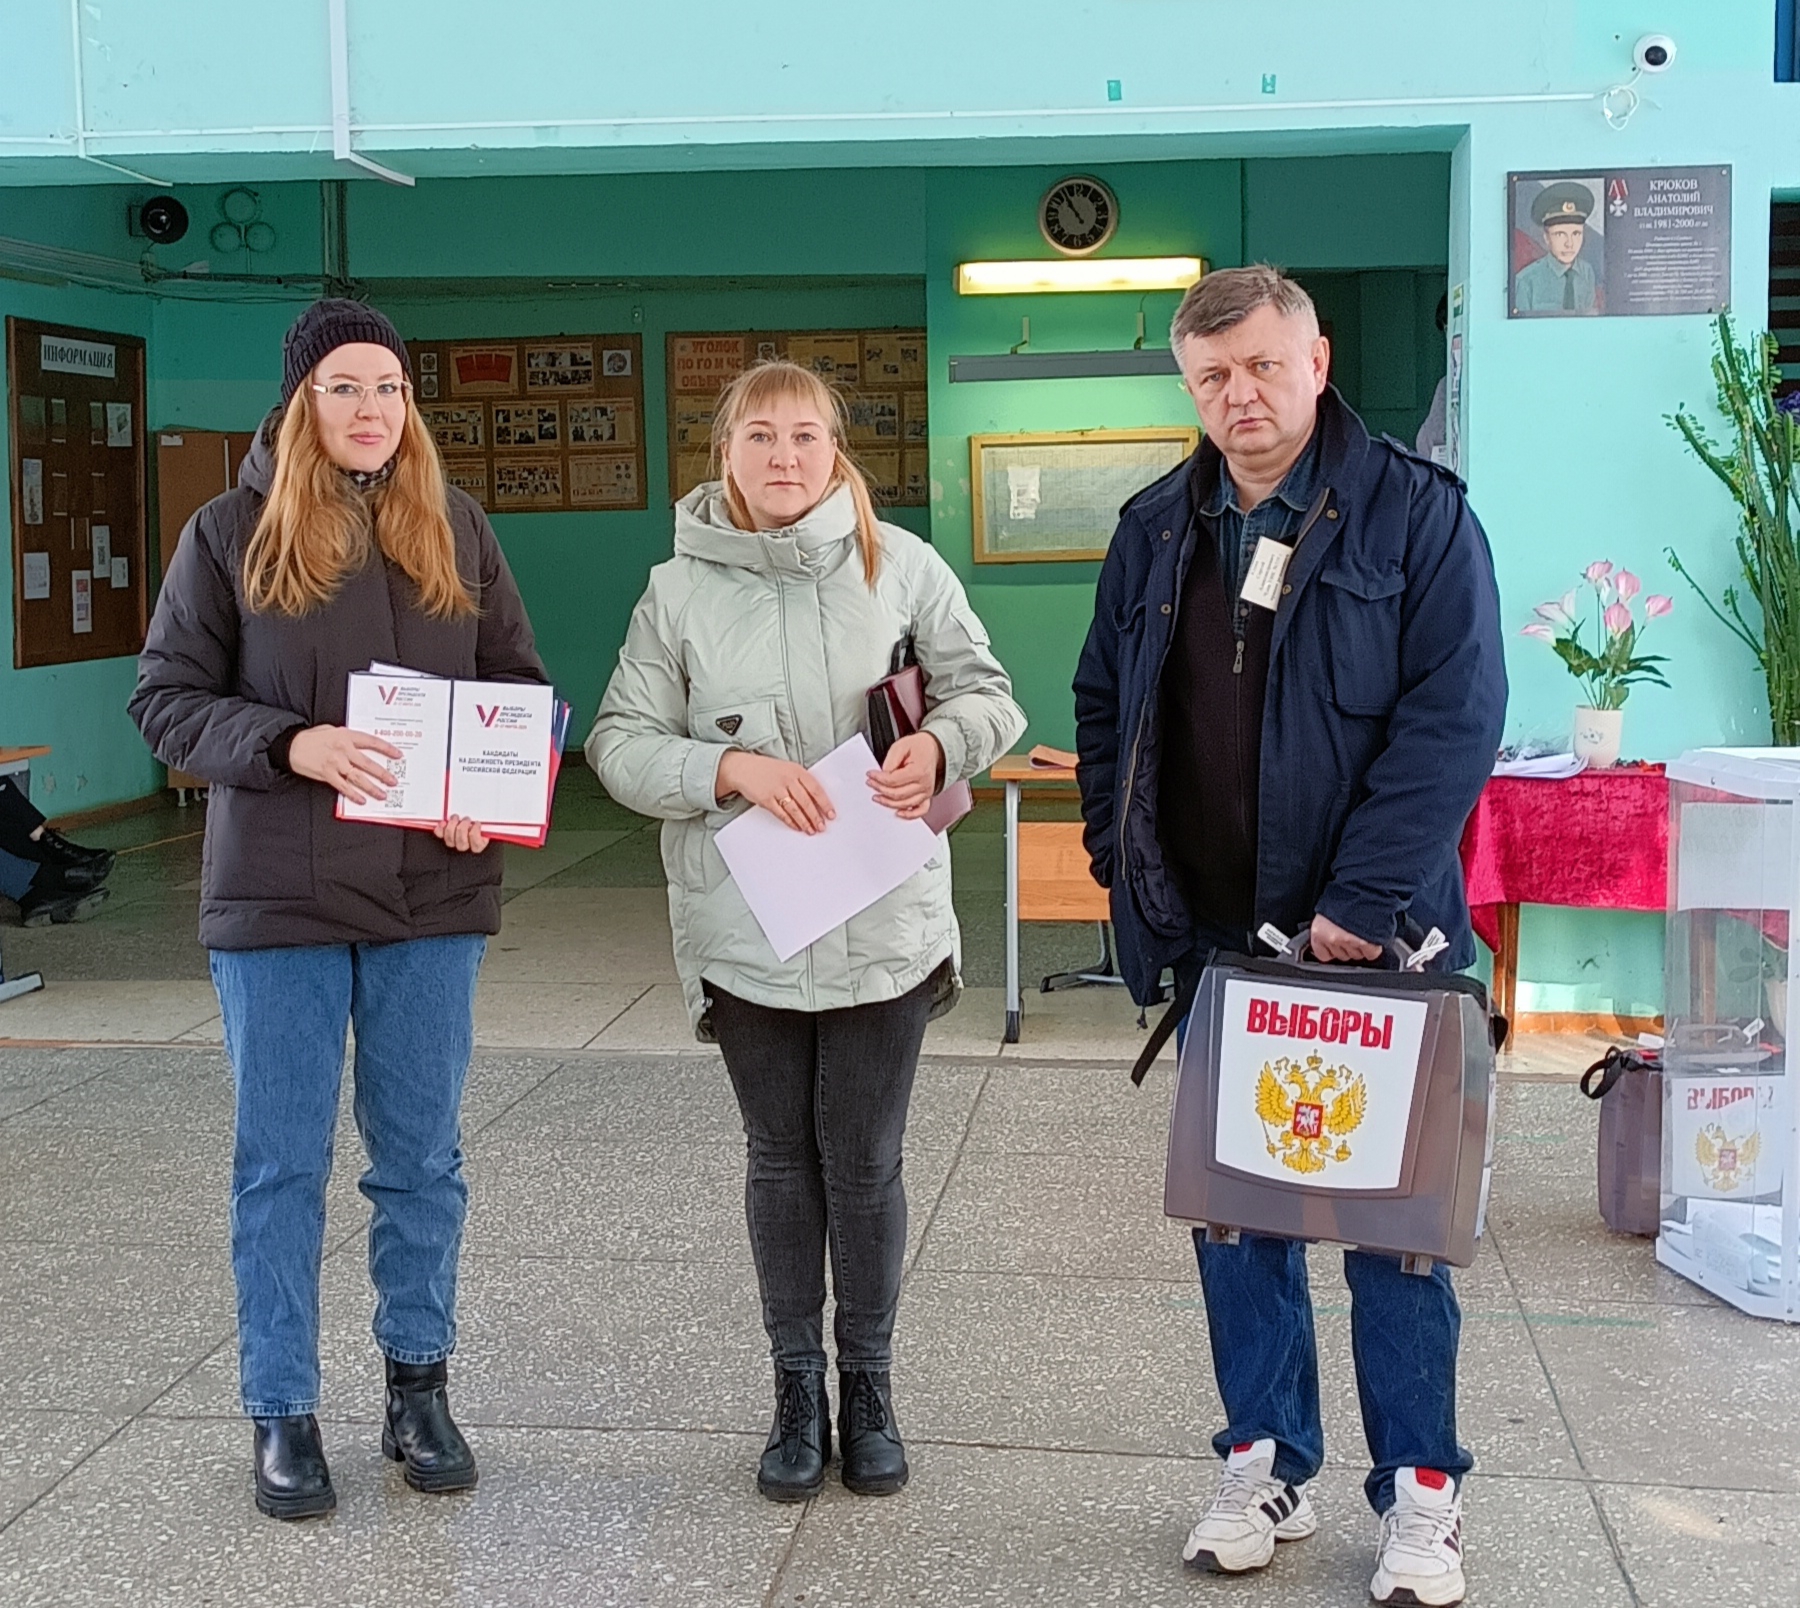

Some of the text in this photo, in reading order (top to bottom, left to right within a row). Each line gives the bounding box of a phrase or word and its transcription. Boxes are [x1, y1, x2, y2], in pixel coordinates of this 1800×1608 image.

[1074, 184, 1084, 197] 12
[1649, 178, 1698, 191] КРЮКОВ
[1646, 190, 1701, 204] АНАТОЛИЙ
[1633, 205, 1714, 217] ВЛАДИМИРОВИЧ
[692, 340, 740, 353] УГОЛОК
[43, 344, 113, 369] ИНФОРМАЦИЯ
[677, 357, 742, 371] ПО ГО И ЧС
[1246, 998, 1394, 1050] ВЫБОРЫ
